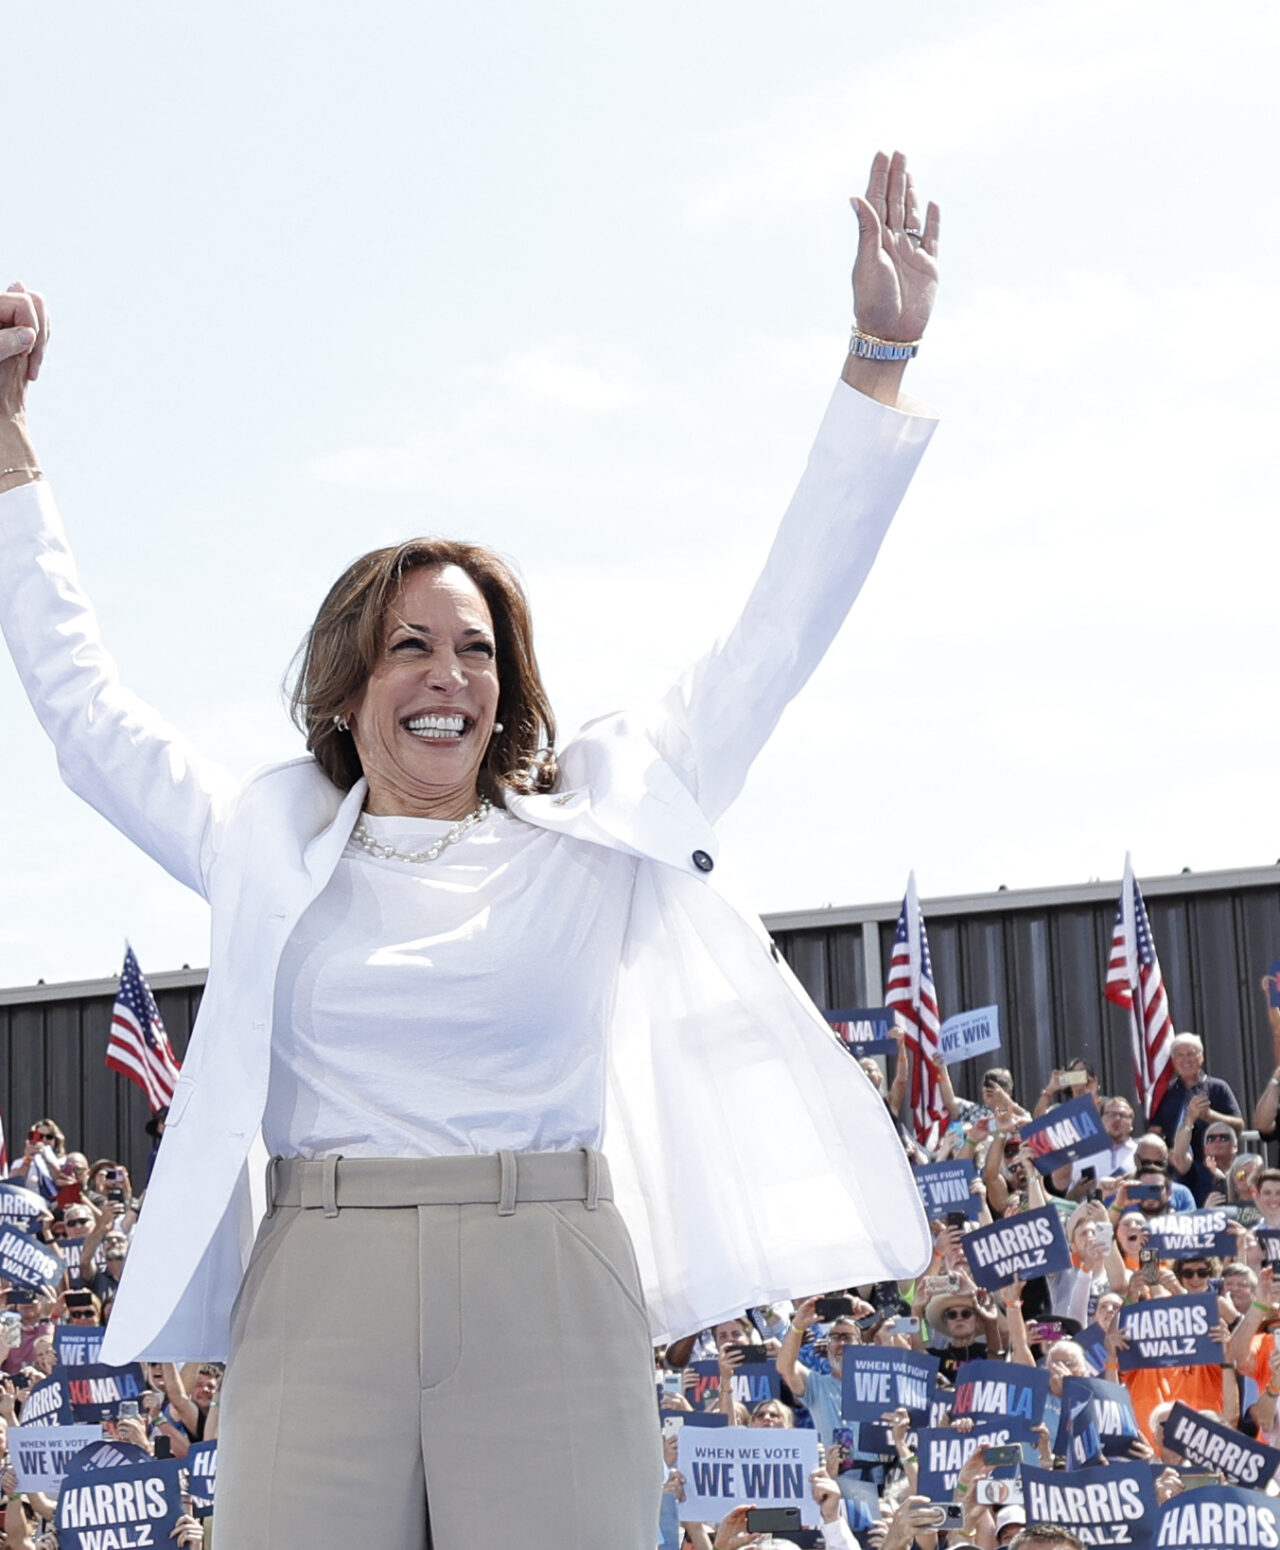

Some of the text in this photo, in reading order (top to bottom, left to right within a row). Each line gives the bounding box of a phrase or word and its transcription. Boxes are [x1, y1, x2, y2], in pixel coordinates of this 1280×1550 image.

[941, 1022, 991, 1053] WE WIN
[1027, 1111, 1098, 1158] KAMALA
[925, 1173, 939, 1182] WE
[940, 1169, 965, 1181] FIGHT
[930, 1178, 969, 1205] WIN
[1150, 1211, 1227, 1236] HARRIS
[973, 1217, 1054, 1267] HARRIS
[1164, 1235, 1216, 1249] WALZ
[1, 1257, 42, 1286] WALZ
[994, 1249, 1048, 1278] WALZ
[1125, 1305, 1209, 1340] HARRIS
[60, 1343, 86, 1366] WE
[1139, 1338, 1197, 1358] WALZ
[856, 1359, 929, 1379] WHEN WE FIGHT
[21, 1382, 63, 1423] ARRIS
[68, 1373, 139, 1405] KAMALA
[695, 1375, 770, 1403] KALA
[854, 1372, 928, 1411] WE WIN
[952, 1381, 1033, 1420] KAMALA
[48, 1440, 63, 1448] WE
[64, 1439, 88, 1447] VOTE
[695, 1447, 800, 1459] WHEN WE VOTE
[930, 1430, 1010, 1472] HARS
[1174, 1416, 1266, 1483] HARRIS
[19, 1451, 49, 1475] WE
[1184, 1447, 1240, 1485] WA
[692, 1462, 804, 1499] WE WIN
[61, 1478, 168, 1529] HARRIS
[1029, 1479, 1145, 1524] HARRIS
[77, 1524, 154, 1550] WALZ
[1071, 1524, 1132, 1545] ALZ
[1156, 1502, 1279, 1548] HARRIS
